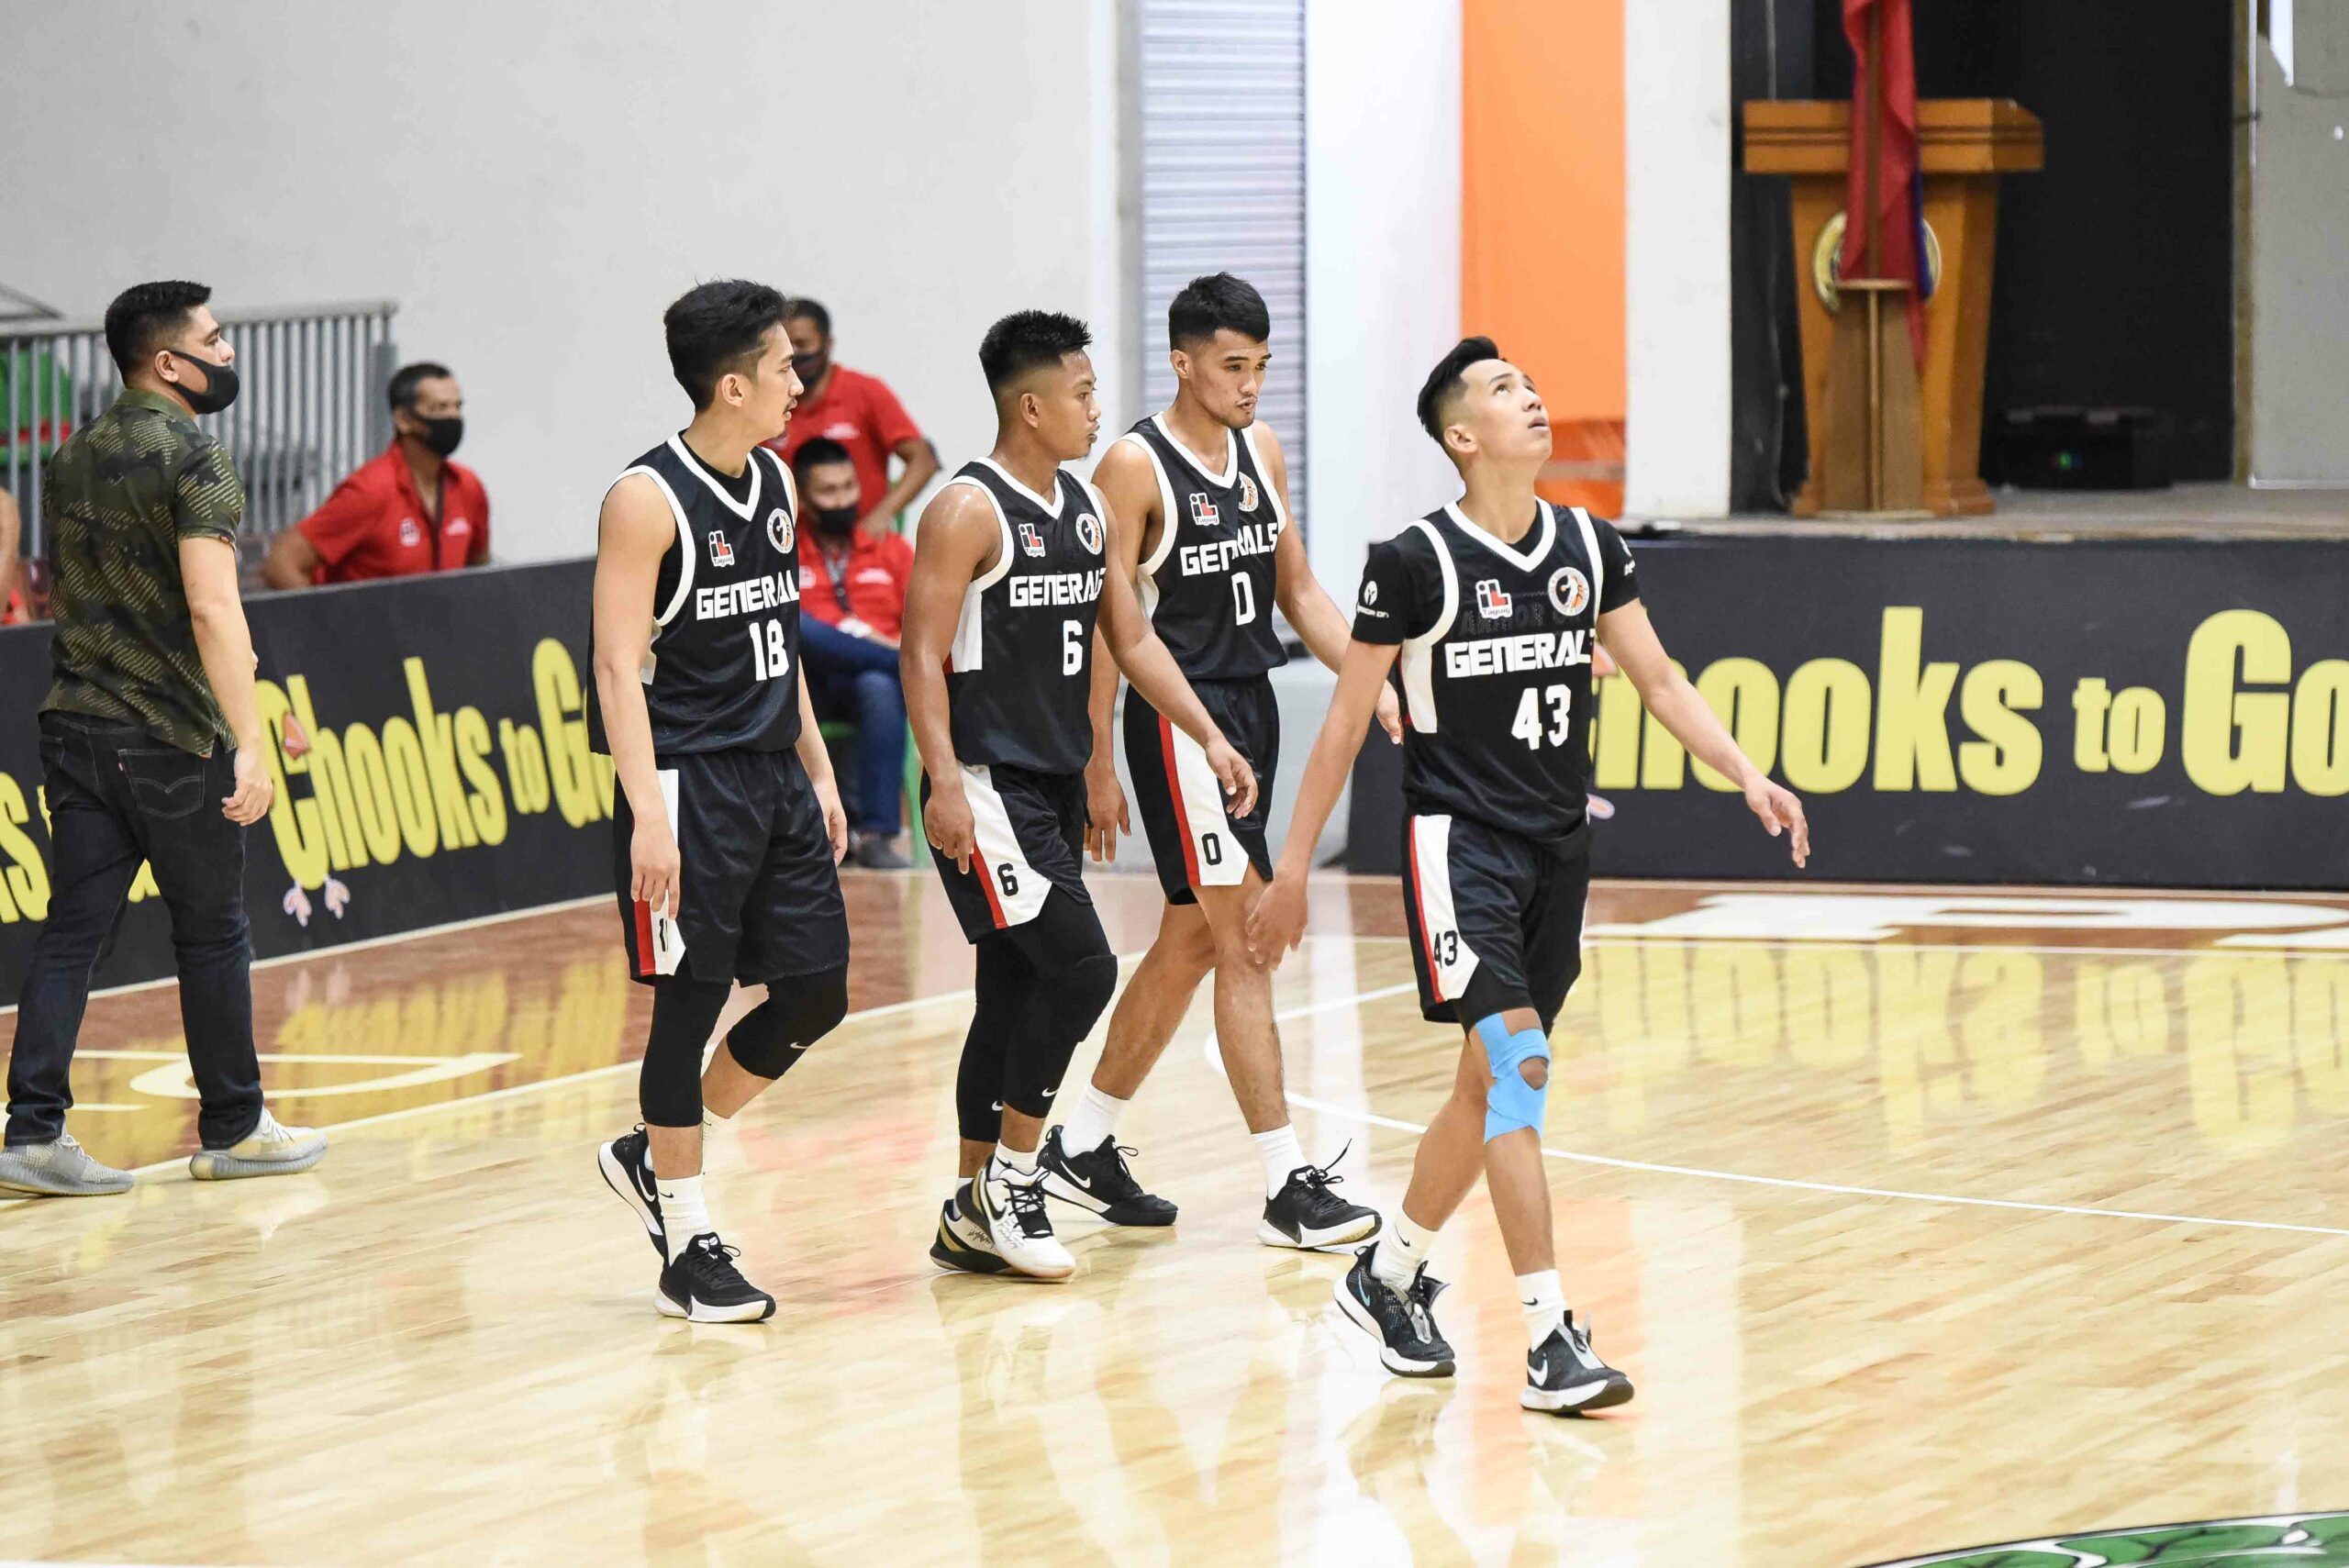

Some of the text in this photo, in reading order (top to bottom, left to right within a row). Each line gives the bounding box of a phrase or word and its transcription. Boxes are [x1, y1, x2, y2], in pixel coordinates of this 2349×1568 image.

[749, 618, 790, 681] 18
[1063, 619, 1083, 676] 6
[1444, 628, 1596, 678] GENERAL
[1511, 684, 1572, 751] 43
[2073, 677, 2166, 774] to
[255, 657, 508, 890] Chooks
[498, 717, 551, 815] to
[1201, 832, 1222, 866] 0
[996, 862, 1019, 896] 6
[1433, 929, 1458, 969] 43
